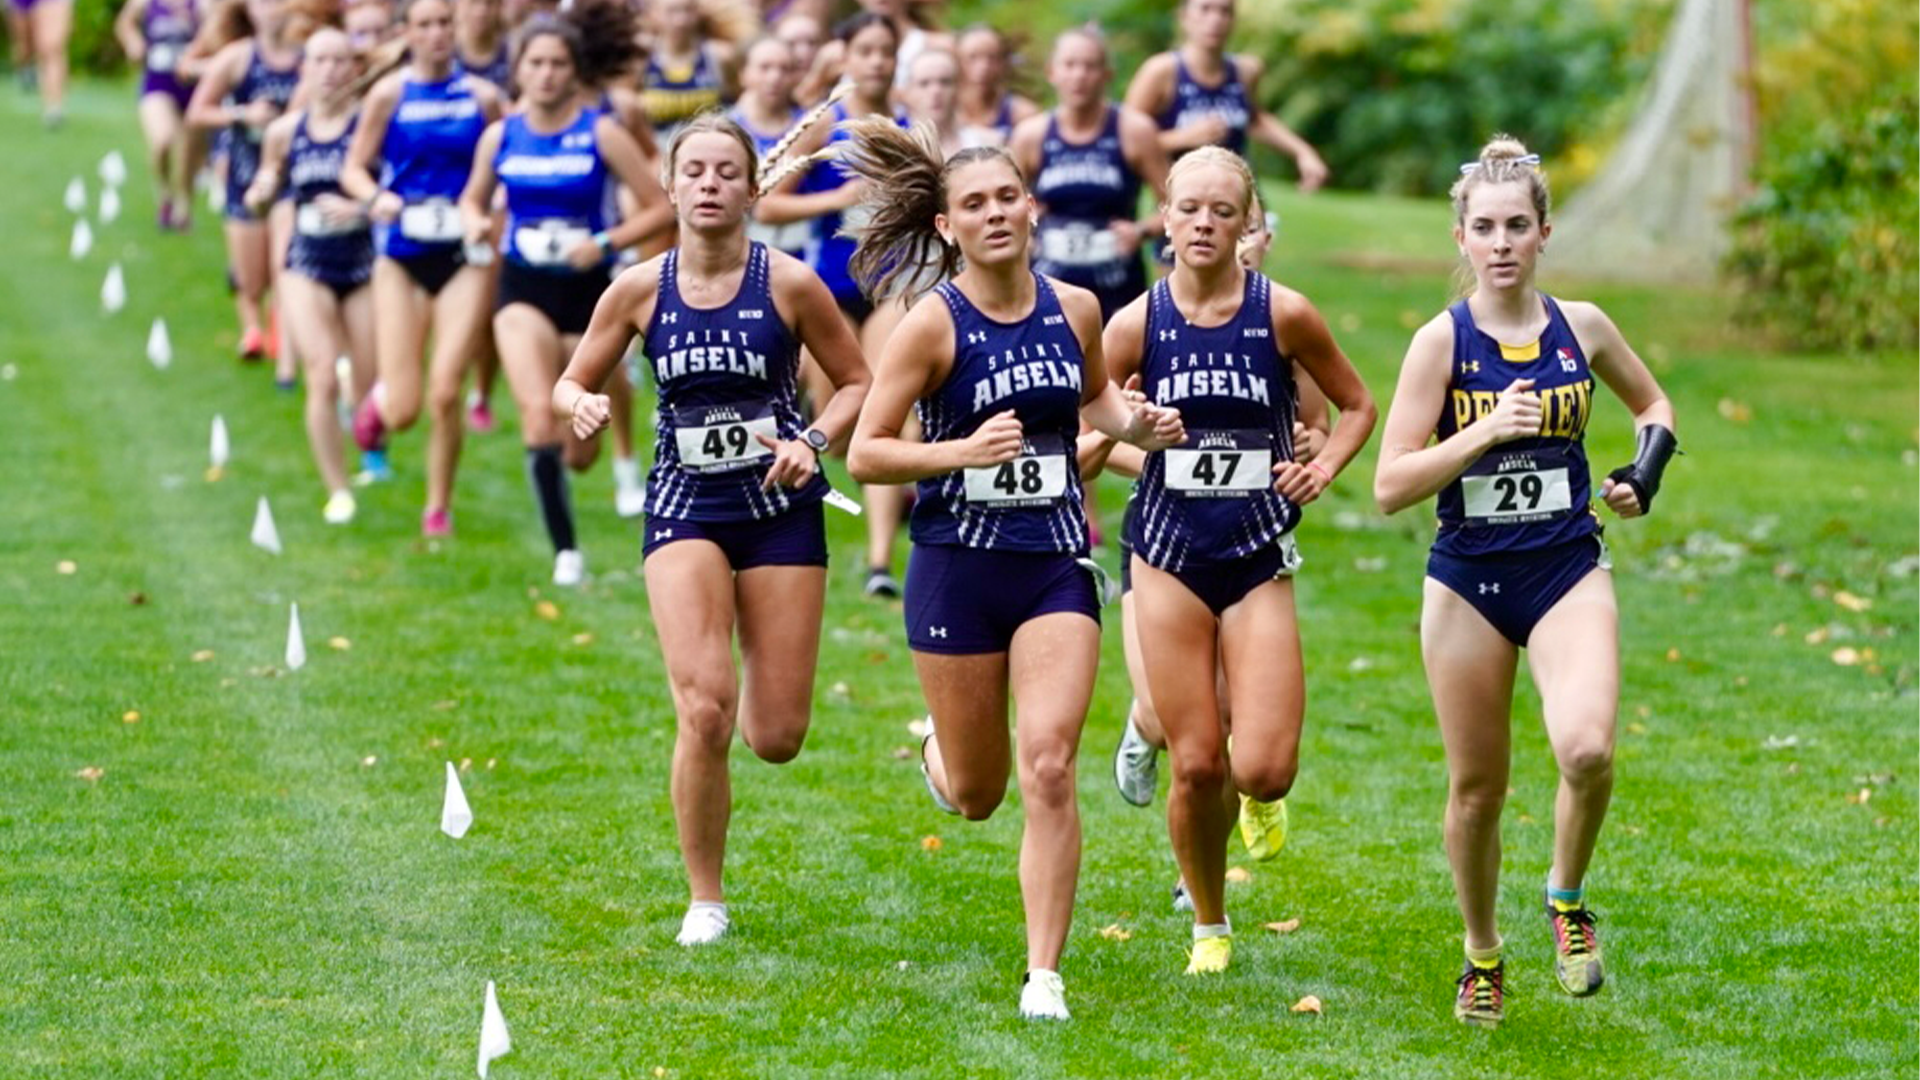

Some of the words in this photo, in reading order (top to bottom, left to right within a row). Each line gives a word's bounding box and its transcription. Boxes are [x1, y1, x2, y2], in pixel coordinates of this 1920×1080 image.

[668, 329, 748, 349] SAINT
[657, 346, 768, 383] ANSELM
[988, 343, 1063, 371] SAINT
[1170, 352, 1251, 371] SAINT
[973, 360, 1082, 413] ANSELM
[1156, 370, 1270, 407] ANSELM
[702, 425, 748, 459] 49
[993, 460, 1043, 495] 48
[1192, 453, 1243, 486] 47
[1494, 474, 1543, 512] 29
